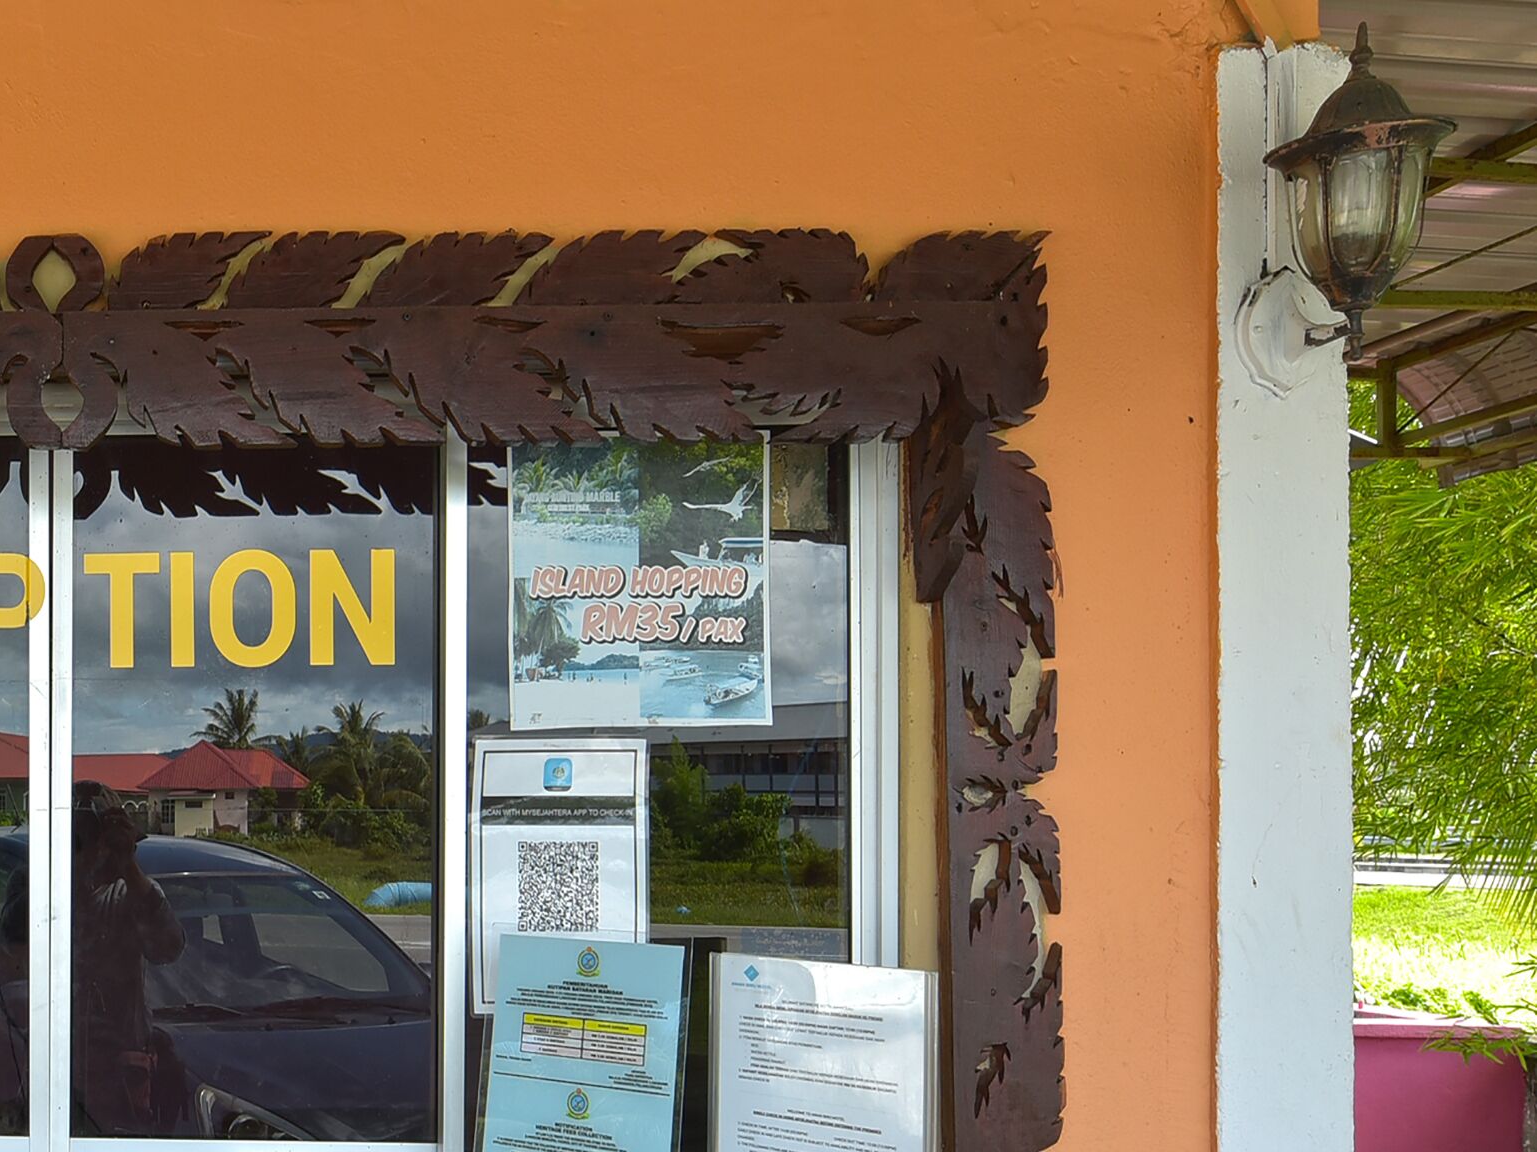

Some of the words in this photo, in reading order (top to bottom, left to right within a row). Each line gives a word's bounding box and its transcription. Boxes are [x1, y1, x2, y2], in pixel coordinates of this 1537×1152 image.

[530, 565, 626, 598] ISLAND
[629, 565, 748, 597] HOPPING
[581, 602, 684, 643] RM35
[698, 617, 747, 643] PAX
[482, 808, 502, 817] SCAN
[503, 808, 520, 817] WITH
[521, 808, 572, 817] MYSEJAHTERA
[573, 808, 588, 817] APP
[588, 808, 599, 817] TO
